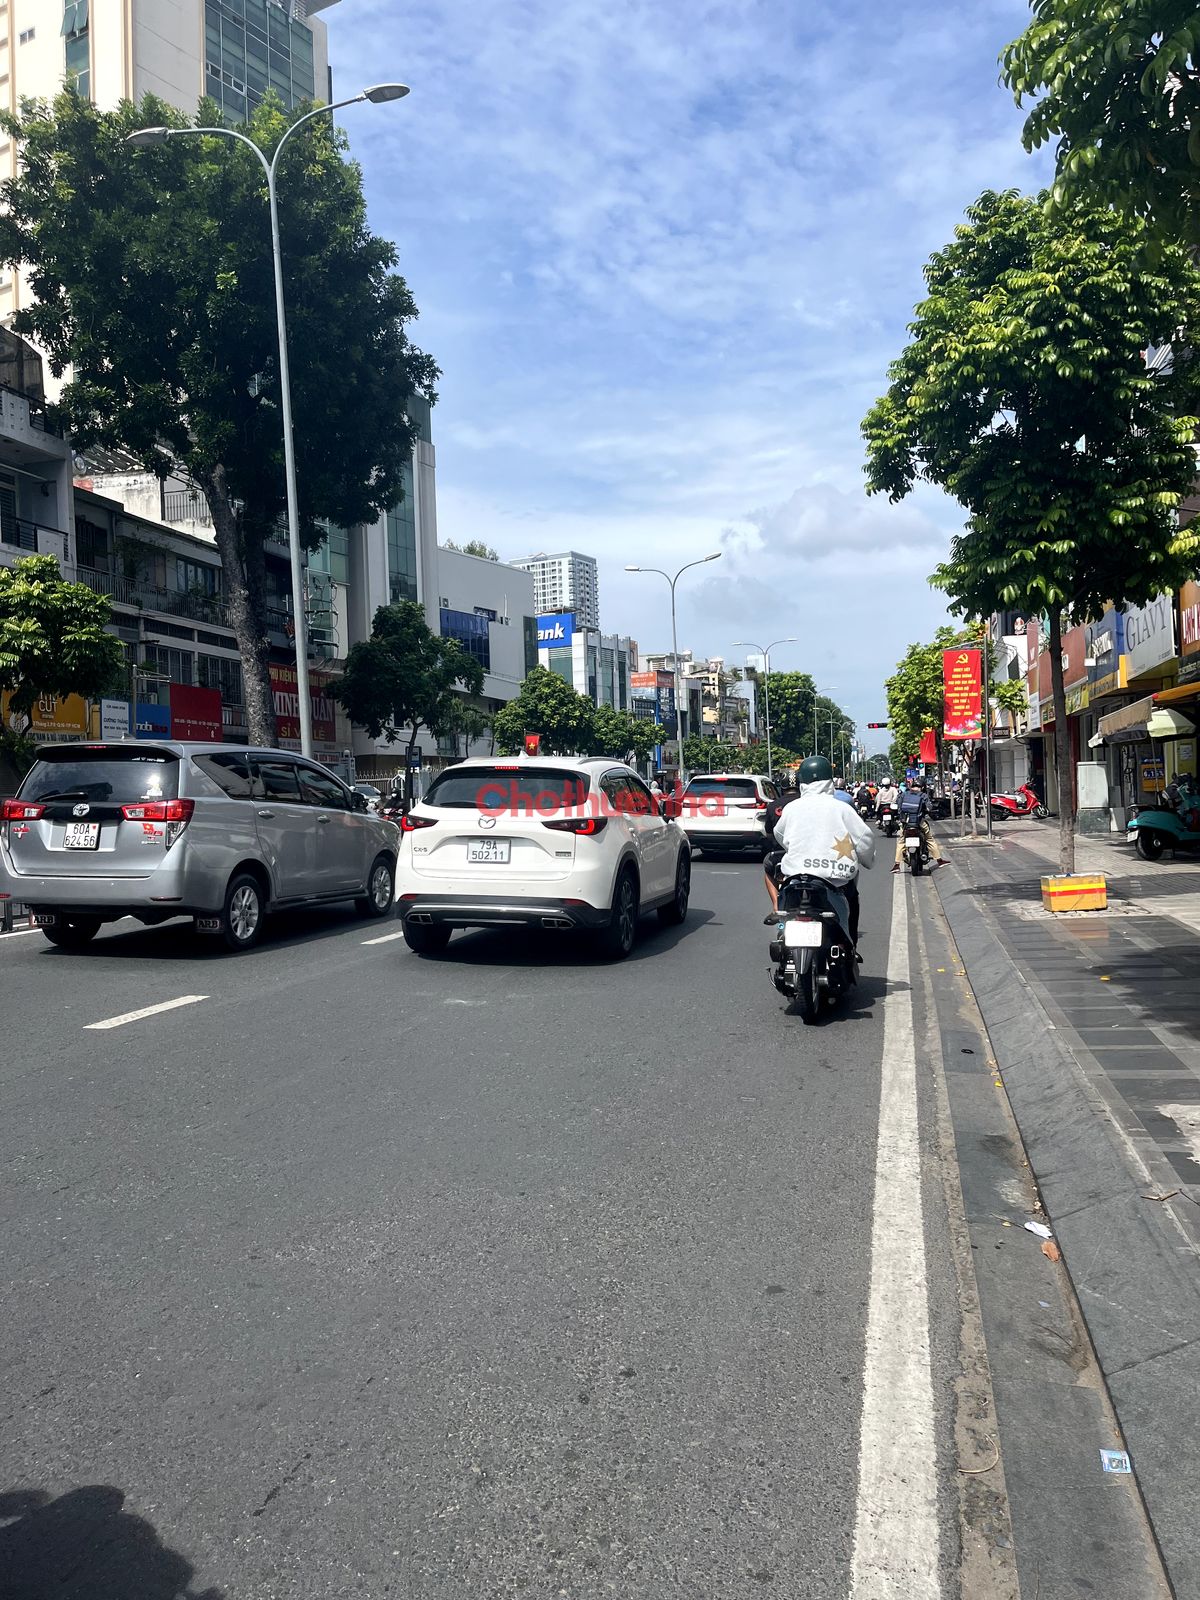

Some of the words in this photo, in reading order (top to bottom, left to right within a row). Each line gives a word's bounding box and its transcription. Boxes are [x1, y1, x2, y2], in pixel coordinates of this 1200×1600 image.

[1126, 598, 1168, 651] GIAVY
[538, 622, 565, 641] ank
[39, 700, 58, 712] CUT
[310, 692, 332, 722] UÂN
[74, 824, 90, 834] 60A
[65, 835, 96, 847] 624.56
[480, 840, 498, 850] 79A
[471, 851, 505, 861] 502.11
